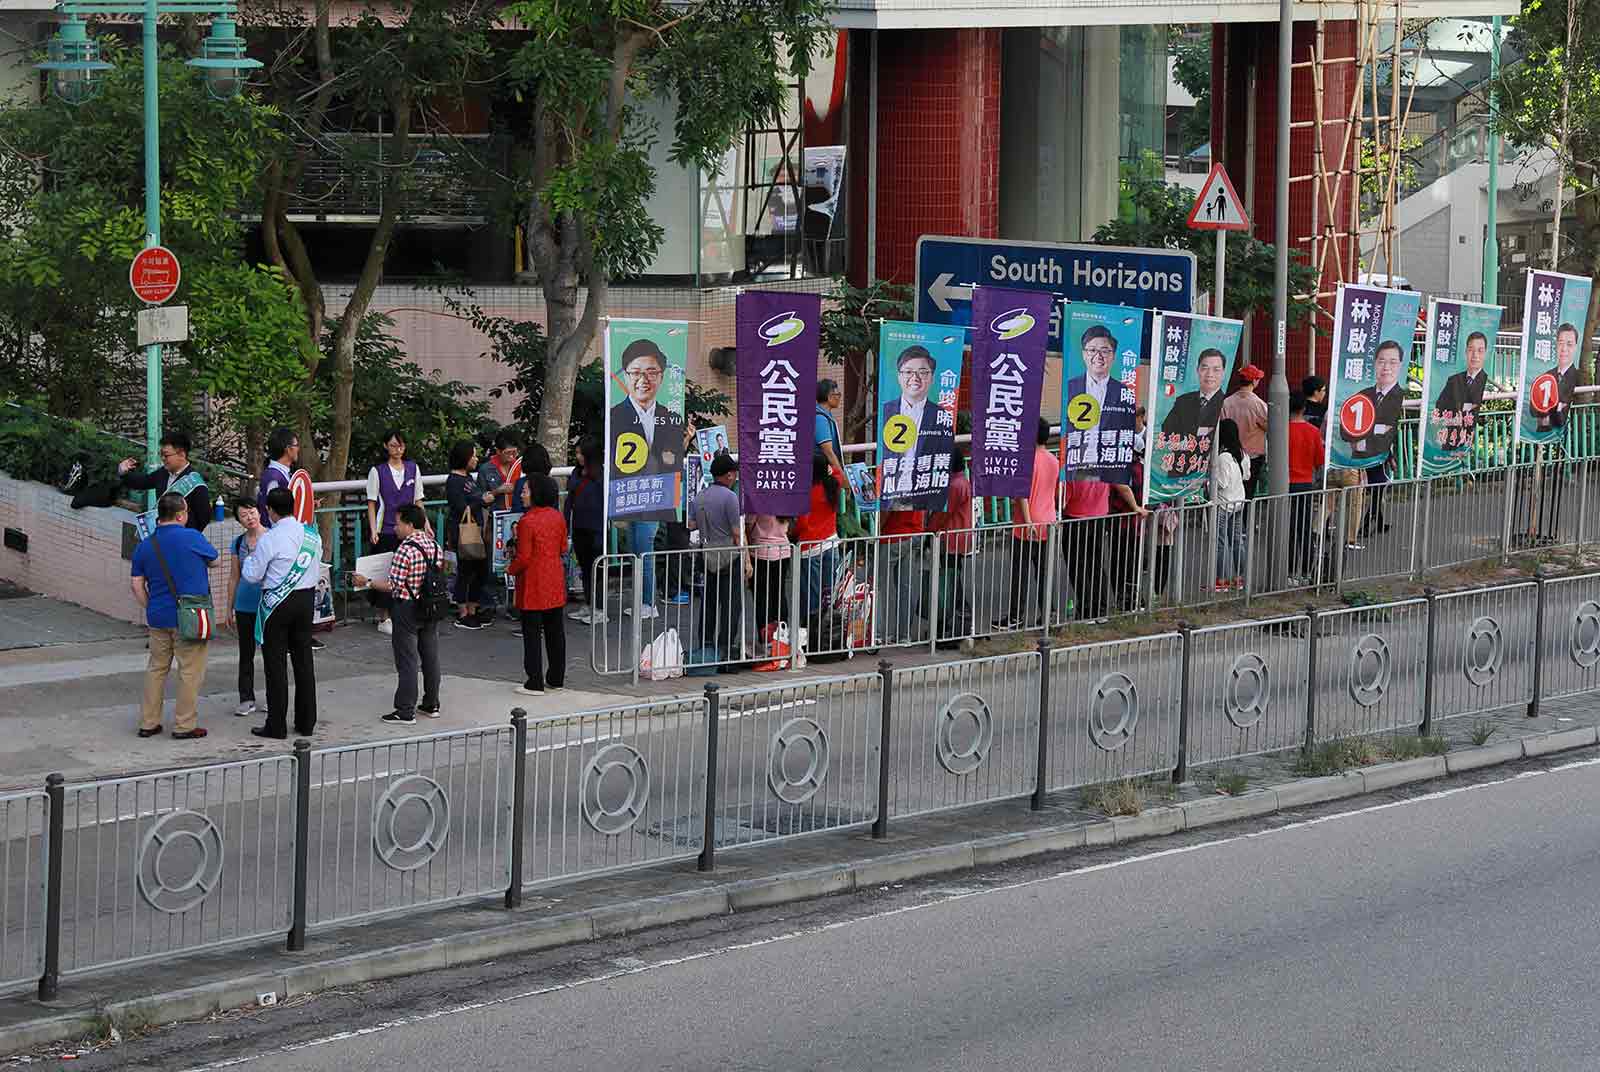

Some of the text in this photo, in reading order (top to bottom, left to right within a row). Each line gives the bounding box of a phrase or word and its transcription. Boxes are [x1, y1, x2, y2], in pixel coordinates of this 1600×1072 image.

[990, 255, 1183, 292] South Horizons
[1369, 304, 1382, 343] MORGAN
[985, 352, 1028, 453] 公民黨
[1539, 380, 1553, 408] 1
[669, 416, 681, 425] YU
[758, 359, 800, 464] 公民黨
[1077, 402, 1092, 422] 2
[1350, 401, 1363, 430] 1
[892, 423, 908, 444] 2
[1067, 430, 1134, 449] 青年專業
[622, 441, 637, 464] 2
[985, 457, 1018, 467] CIVIC
[756, 471, 796, 480] CIVIC
[883, 453, 951, 476] 青年專業
[985, 467, 1018, 476] PARTY
[756, 480, 796, 489] PARTY
